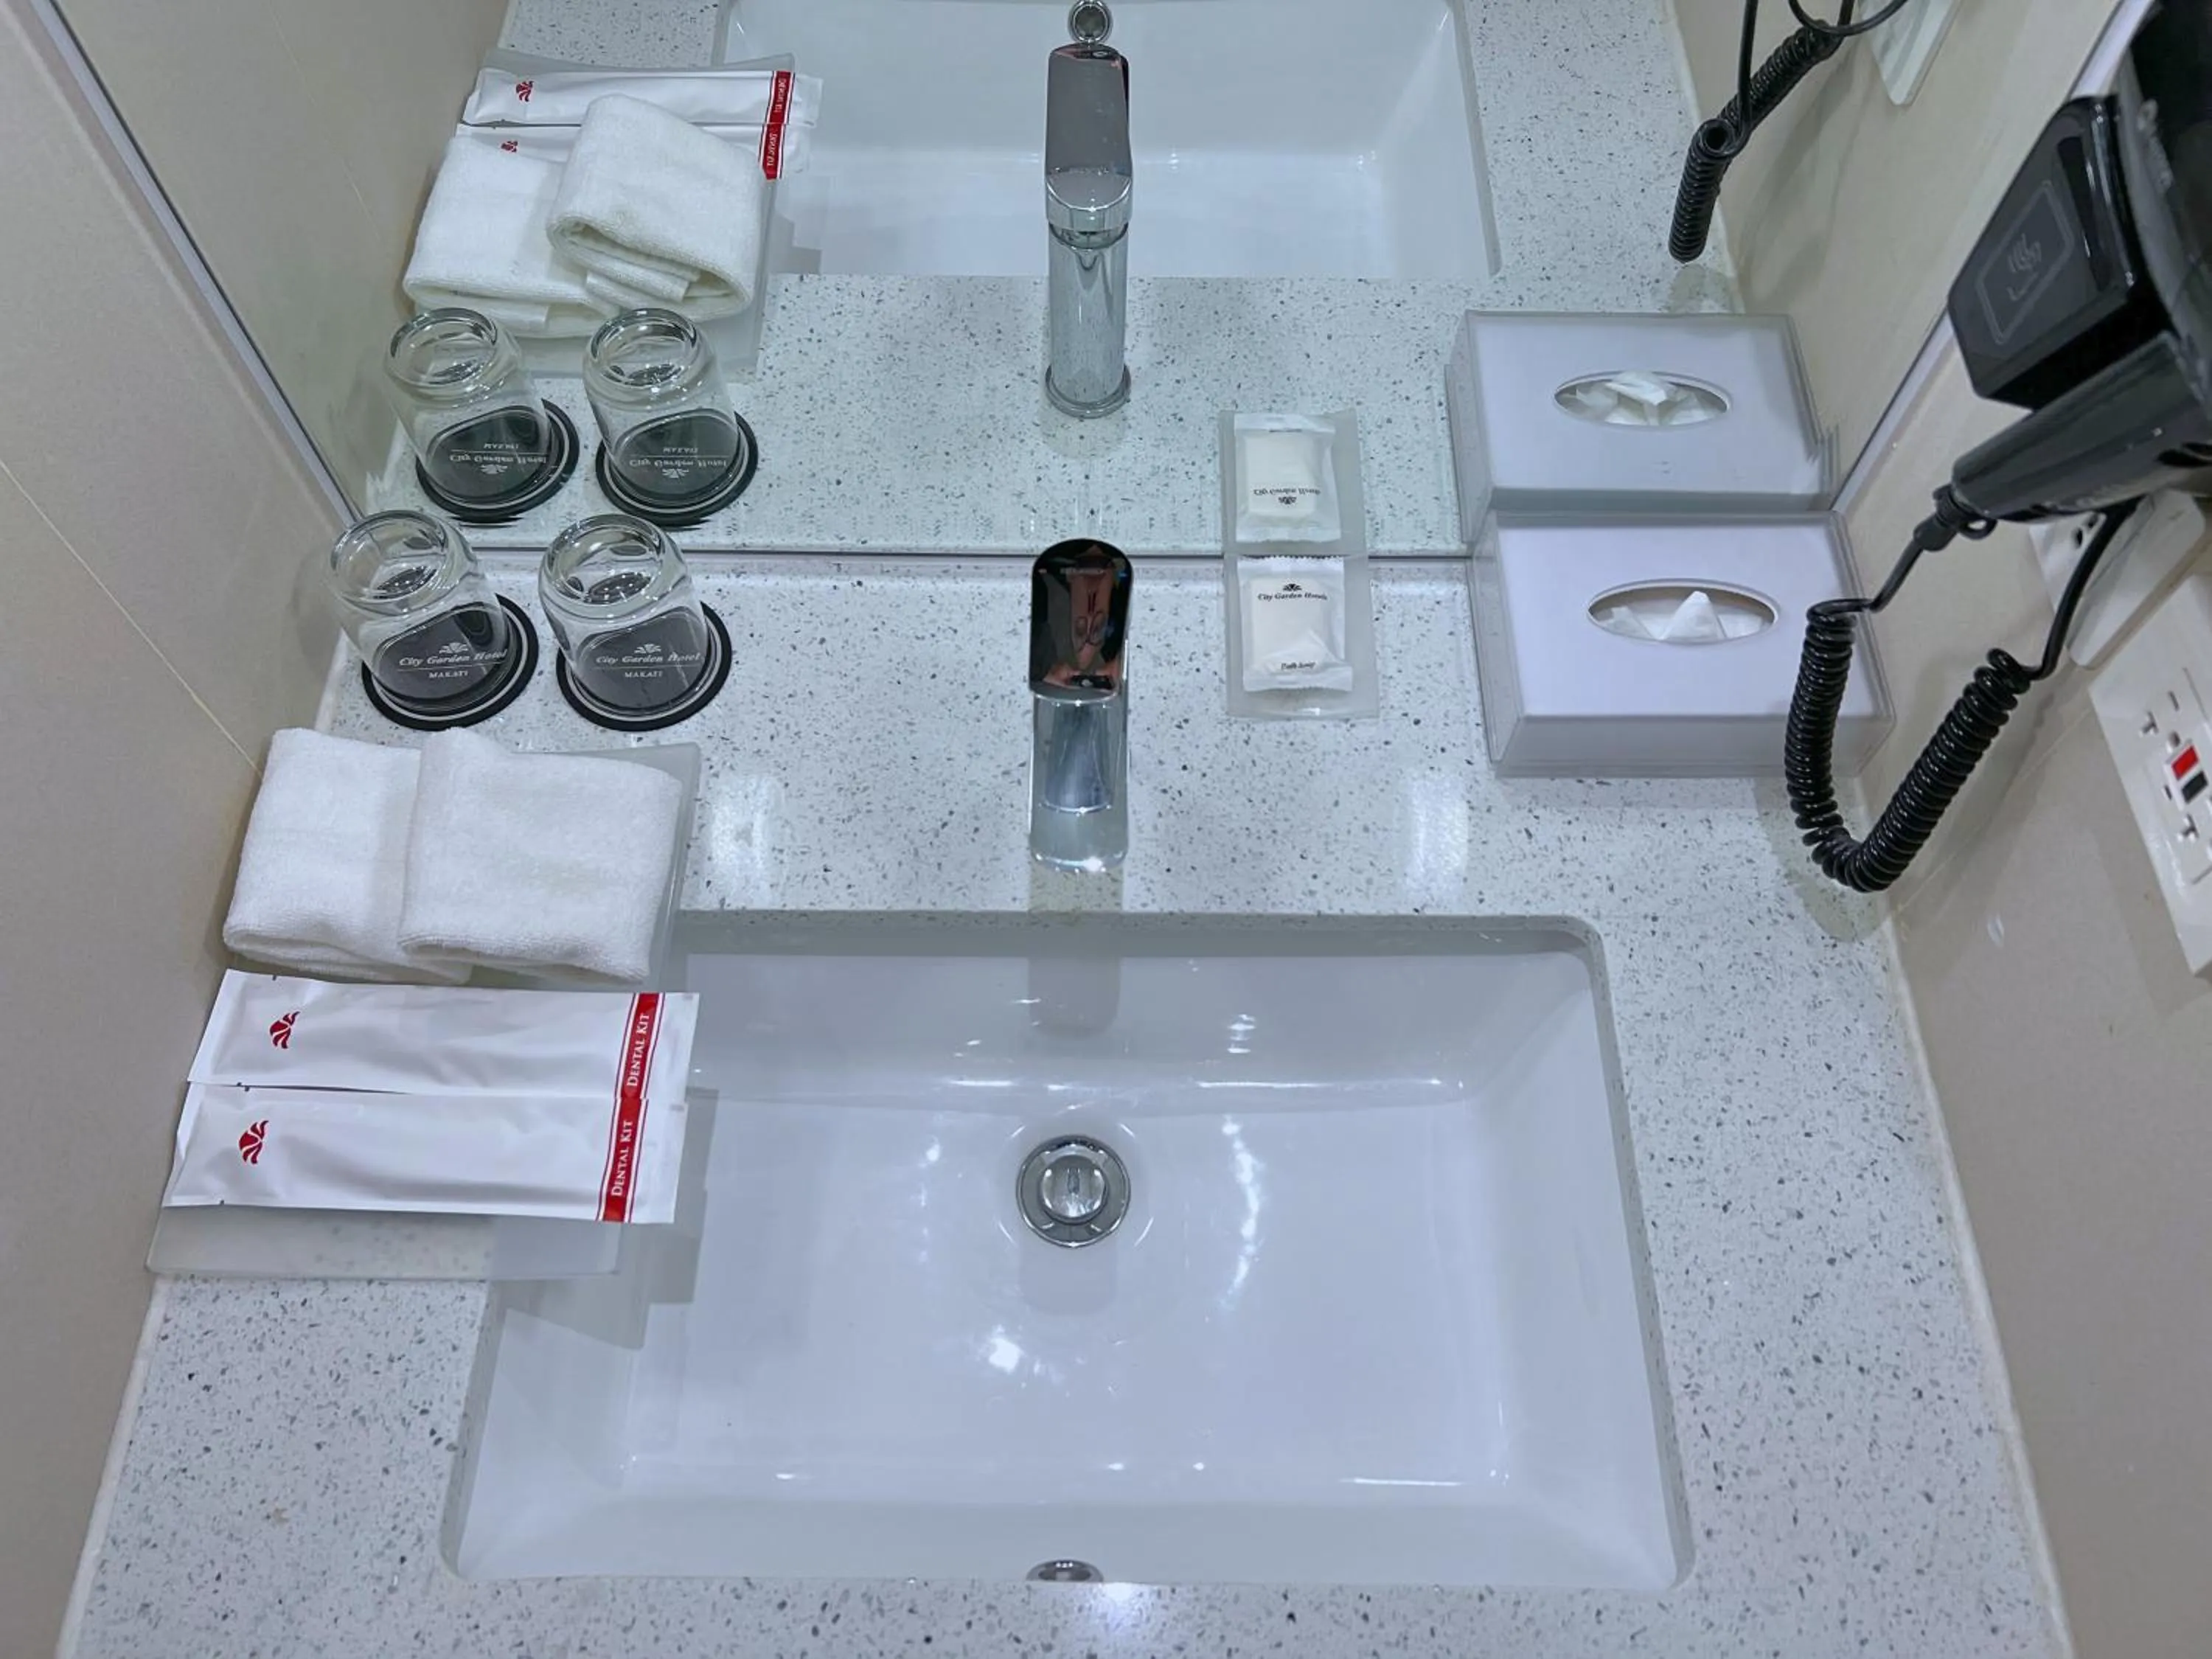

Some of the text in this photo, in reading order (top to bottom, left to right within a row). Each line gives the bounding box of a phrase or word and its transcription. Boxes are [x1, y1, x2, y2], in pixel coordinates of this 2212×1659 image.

[398, 648, 508, 667] City Garden Hotel
[595, 651, 701, 665] City Garden Hotel
[428, 669, 469, 679] MAKATI
[624, 670, 664, 678] MAKATI
[627, 1014, 650, 1086] DENTAL KIT
[611, 1120, 633, 1196] DENTAL KIT
